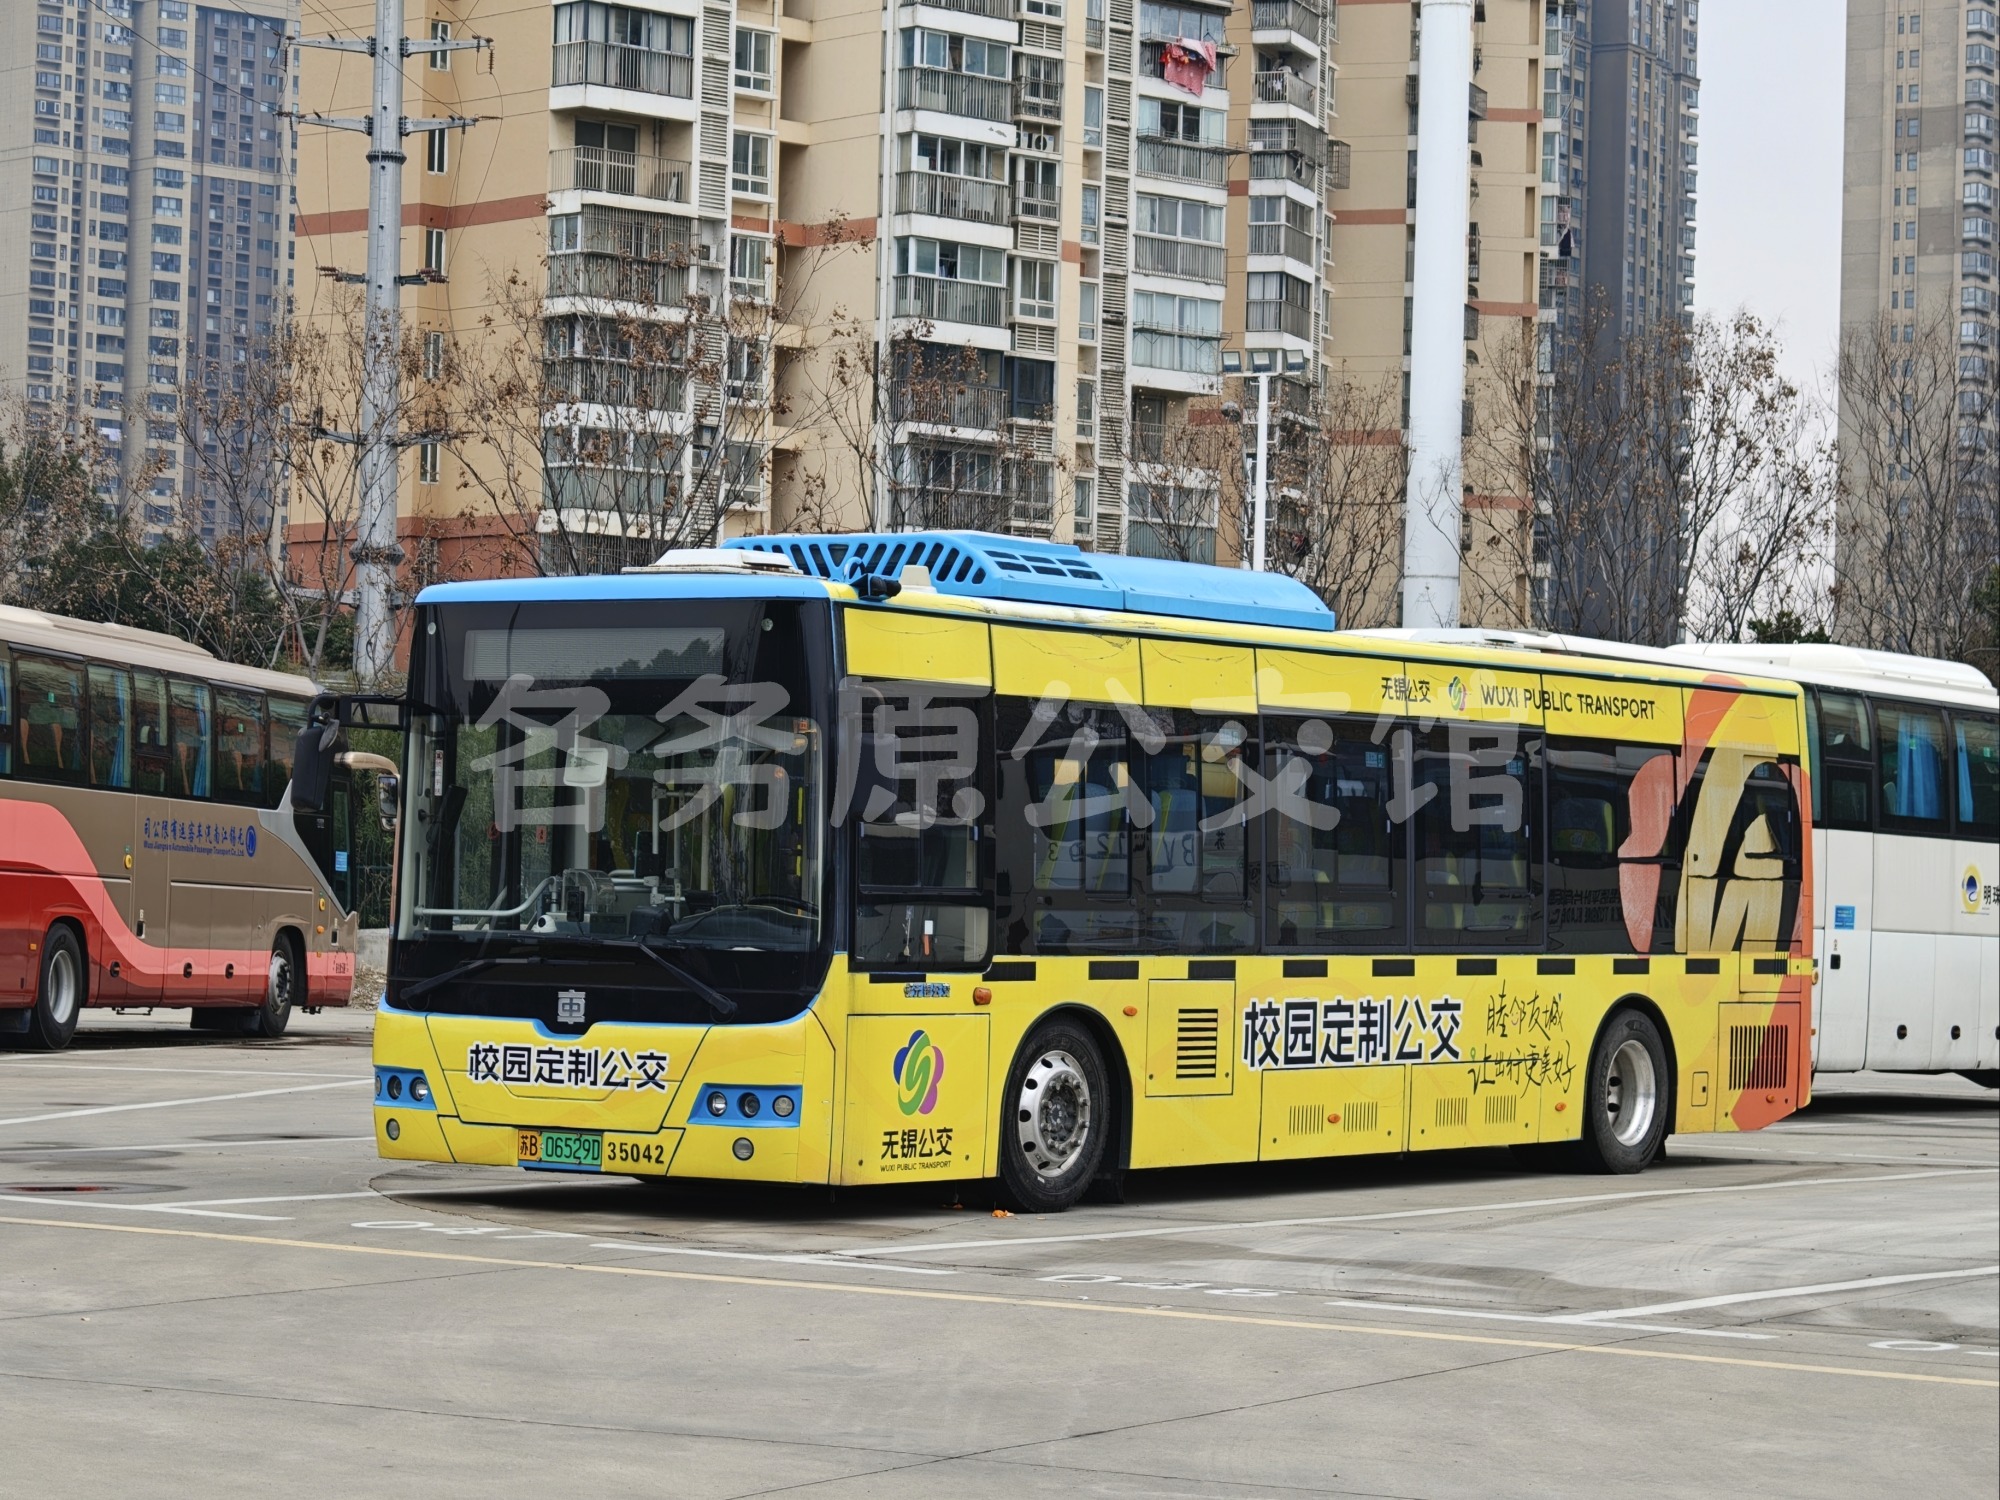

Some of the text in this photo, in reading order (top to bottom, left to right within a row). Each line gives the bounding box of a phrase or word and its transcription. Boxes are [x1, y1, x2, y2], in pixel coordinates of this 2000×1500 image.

[1381, 677, 1431, 703] 无锡公交
[1480, 685, 1656, 720] WUXI PUBLIC TRANSPORT
[1243, 997, 1462, 1068] 校园定制公交
[467, 1042, 668, 1092] 校园定制公交
[1468, 1040, 1577, 1099] 让出行更美好
[608, 1142, 664, 1164] 35042
[881, 1127, 953, 1160] 无锡公交
[880, 1161, 951, 1172] WUXI PUBLIC TRANSPORT
